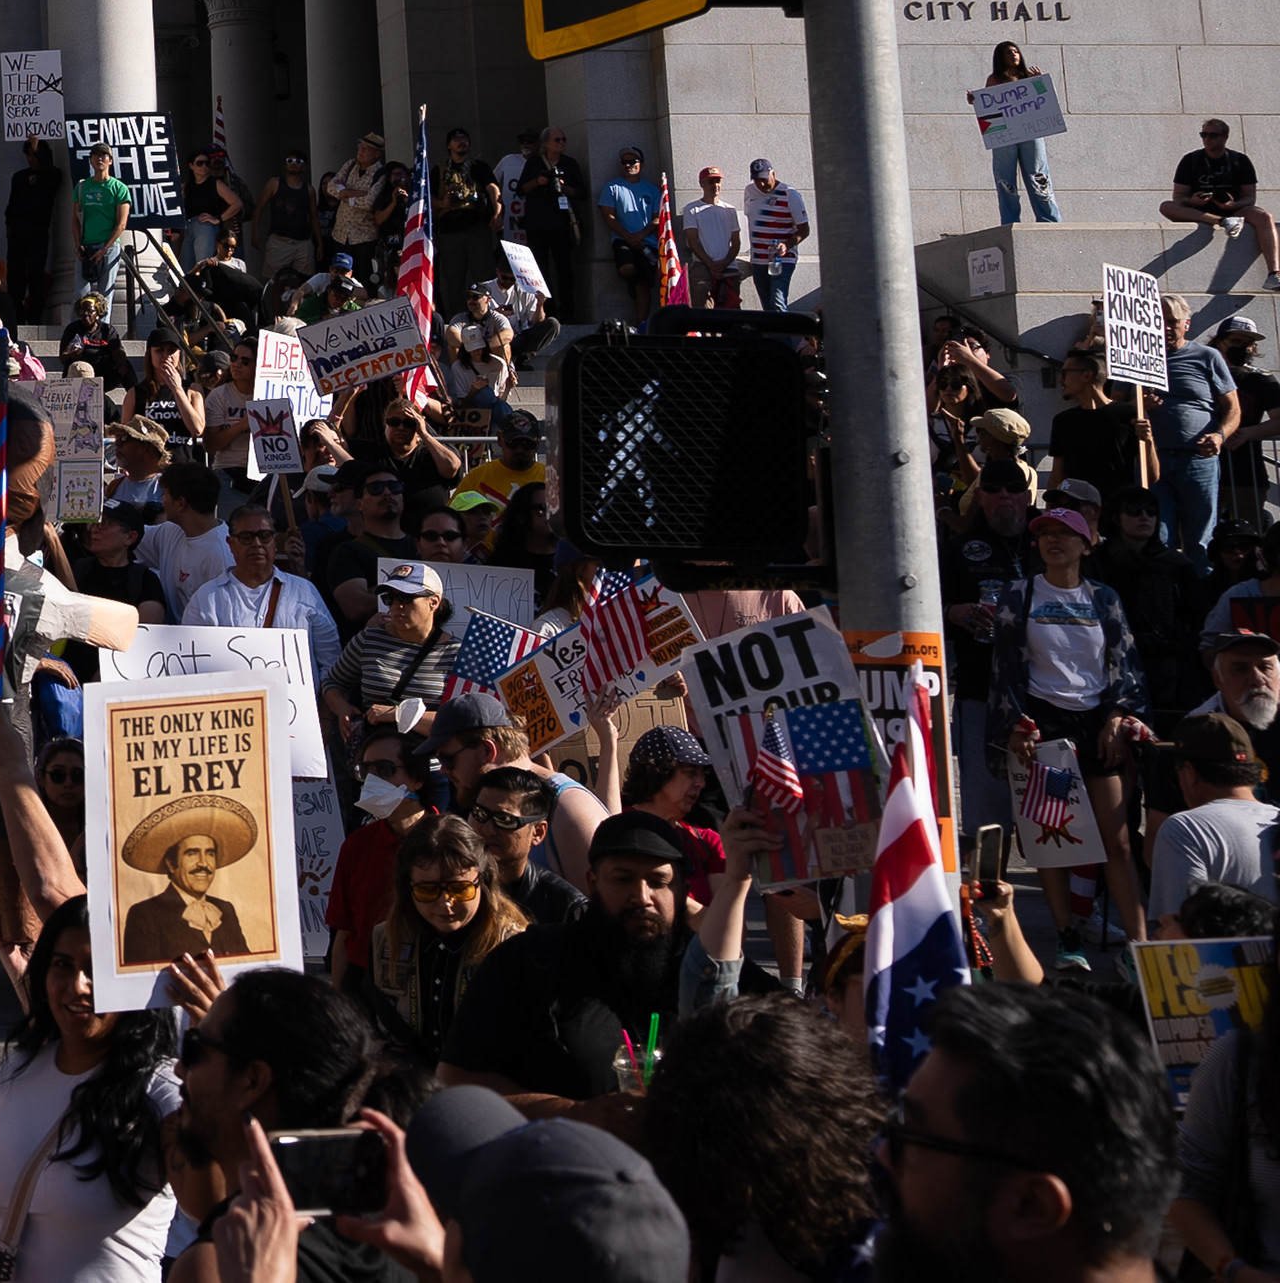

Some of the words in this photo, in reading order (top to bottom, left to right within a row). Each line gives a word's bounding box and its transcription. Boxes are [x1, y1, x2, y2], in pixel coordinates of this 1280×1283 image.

[903, 1, 975, 21] CITY
[990, 2, 1072, 21] HALL
[5, 54, 37, 72] WE
[4, 73, 37, 93] THE
[998, 96, 1046, 118] Trump
[25, 120, 63, 139] KINGS
[65, 115, 170, 148] REMOVE
[1128, 271, 1159, 303] MORE
[1108, 292, 1152, 328] KINGS
[302, 326, 340, 354] We
[1130, 328, 1164, 359] MORE
[283, 370, 305, 382] AND
[319, 343, 428, 395] DICTATORS
[262, 437, 289, 454] NO
[264, 453, 292, 462] KINGS
[542, 639, 587, 671] Yes
[693, 617, 821, 708] NOT
[120, 716, 155, 738] THE
[160, 711, 204, 734] ONLY
[210, 707, 255, 729] KING
[126, 742, 146, 762] IN
[152, 738, 182, 759] MY
[188, 734, 229, 757] LIFE
[235, 732, 253, 752] IS
[132, 765, 171, 797] EL
[181, 758, 247, 794] REY
